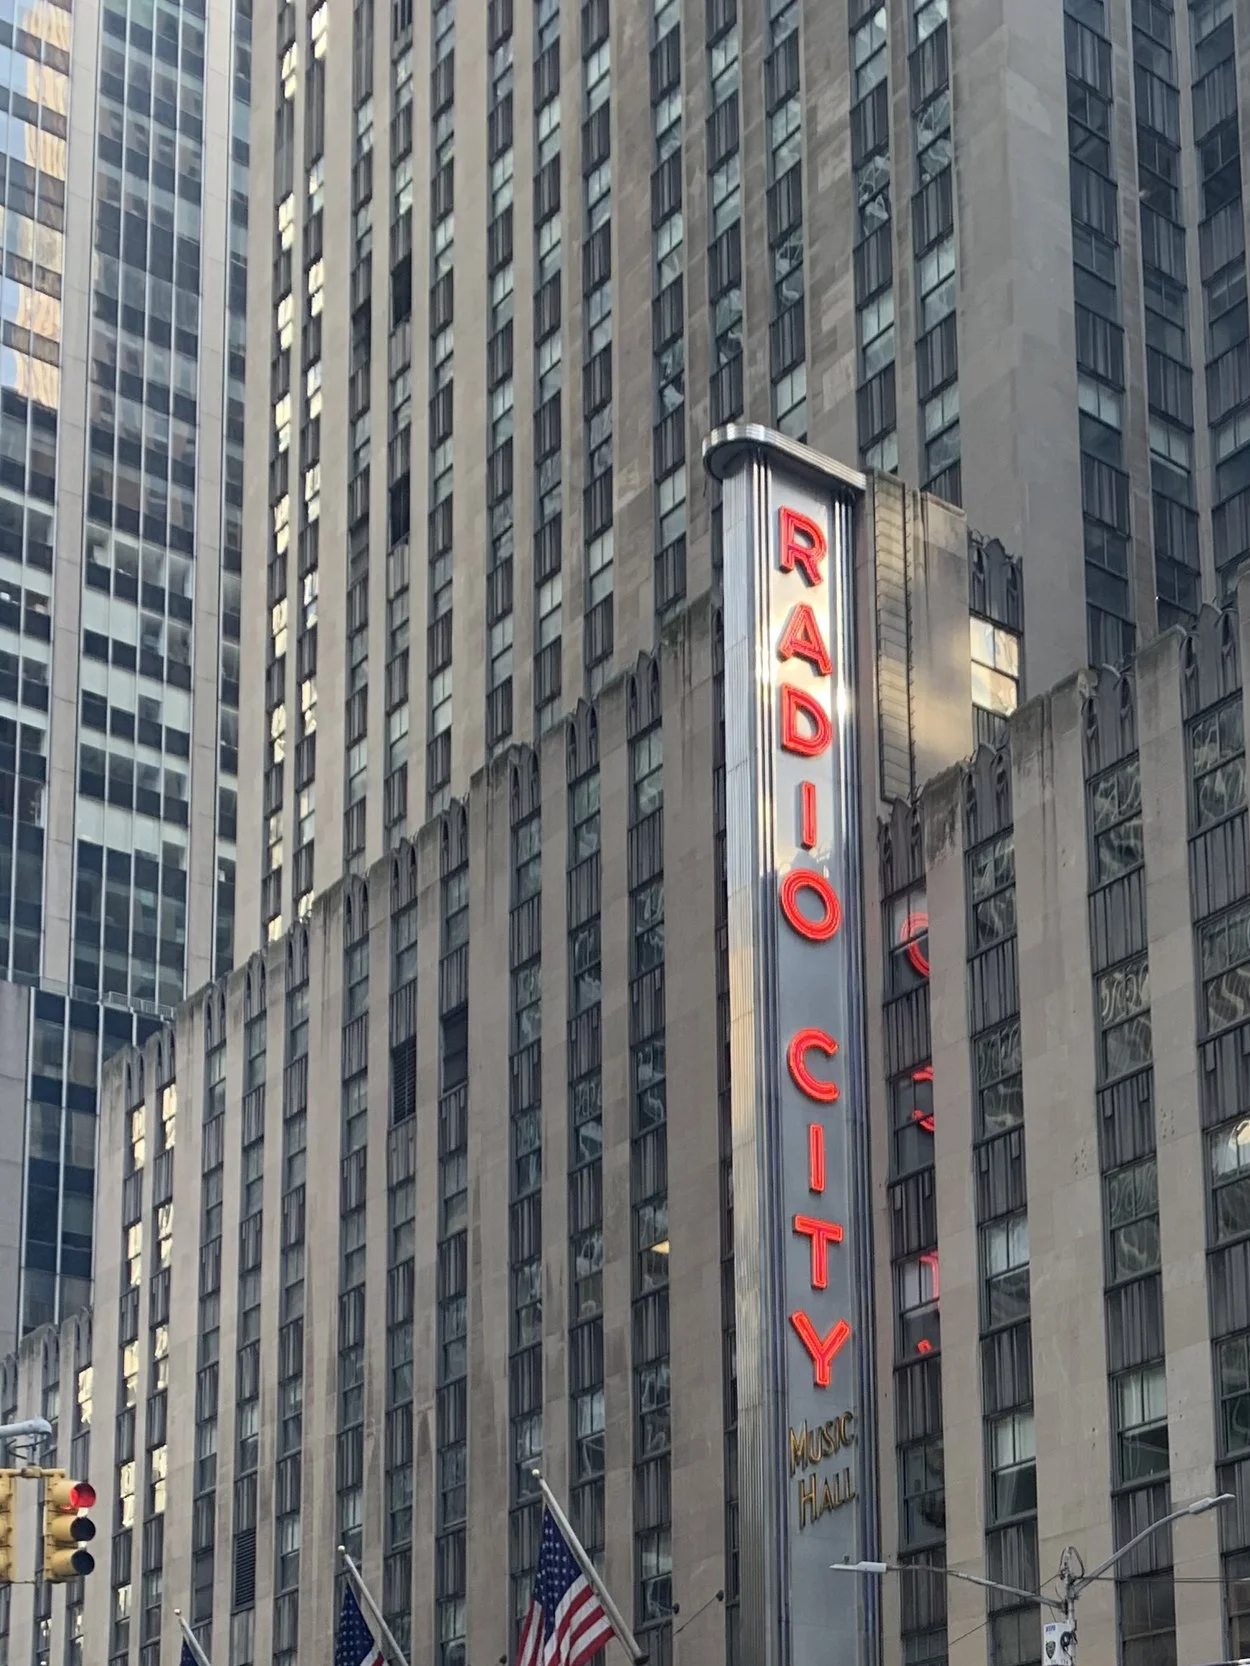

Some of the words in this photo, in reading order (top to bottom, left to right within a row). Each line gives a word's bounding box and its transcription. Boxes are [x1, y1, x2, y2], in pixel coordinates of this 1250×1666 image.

[776, 504, 842, 942] RADIO
[787, 1027, 851, 1387] CITY
[788, 1410, 857, 1478] MUSIC
[798, 1467, 859, 1530] HALL
